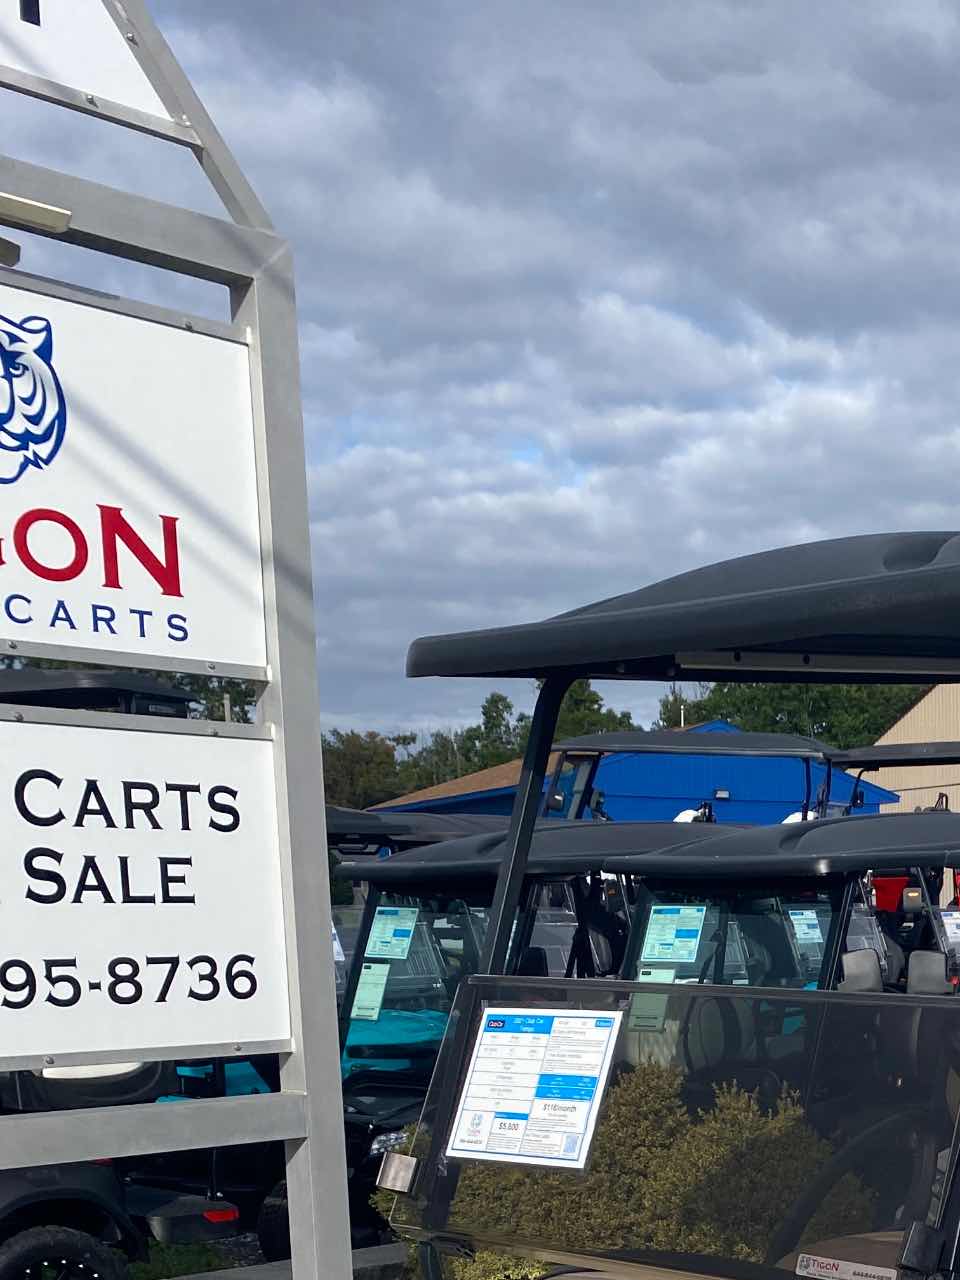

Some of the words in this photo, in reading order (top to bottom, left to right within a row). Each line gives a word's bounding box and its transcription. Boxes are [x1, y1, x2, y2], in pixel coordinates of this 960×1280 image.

[0, 503, 184, 598] ON
[4, 593, 189, 642] CARTS
[14, 768, 241, 833] CARTS
[23, 846, 196, 905] SALE
[811, 1258, 840, 1272] TIGON
